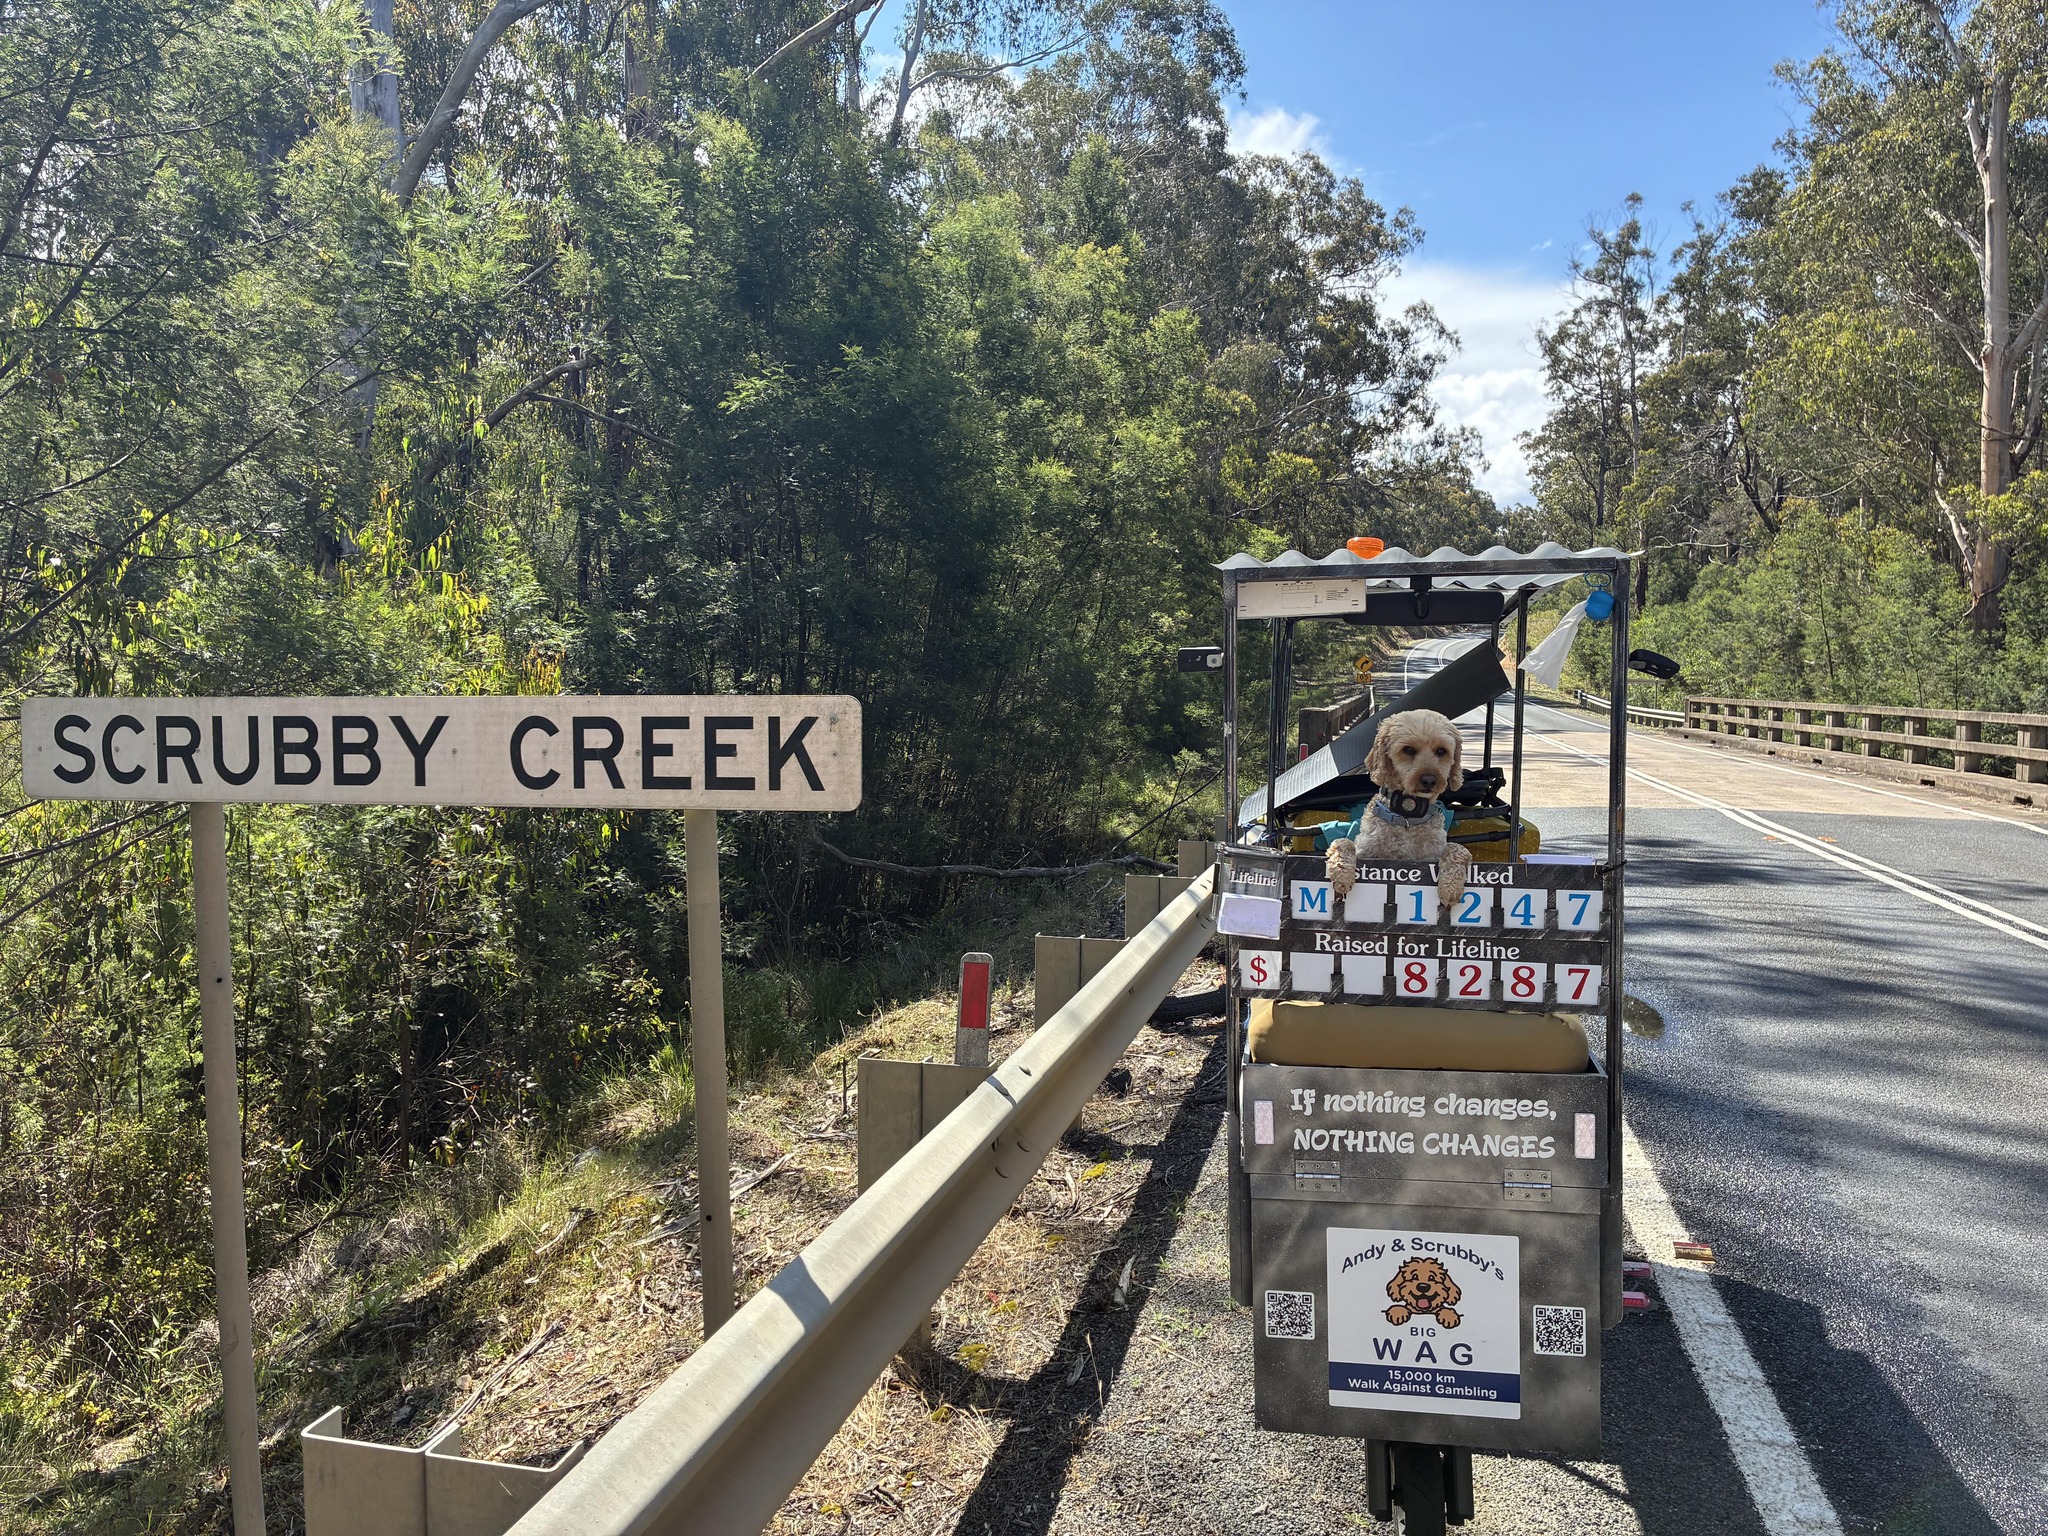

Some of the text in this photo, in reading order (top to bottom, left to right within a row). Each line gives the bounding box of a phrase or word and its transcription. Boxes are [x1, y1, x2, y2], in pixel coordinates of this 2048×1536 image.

[53, 714, 826, 792] SCRUBBY CREEK
[1229, 870, 1278, 887] Lifeline
[1324, 861, 1421, 882] stance
[1298, 886, 1329, 913] M
[1314, 932, 1520, 960] Raised for Lifeline
[1249, 954, 1268, 986] $
[1290, 1088, 1557, 1121] If nothing changes,
[1293, 1128, 1556, 1159] NOTHING CHANGES
[1341, 1237, 1505, 1282] Andy & Scrubby's
[1410, 1326, 1437, 1337] BIG
[1348, 1378, 1498, 1400] Walk Against Gambling
[1388, 1369, 1456, 1384] 15,000 km
